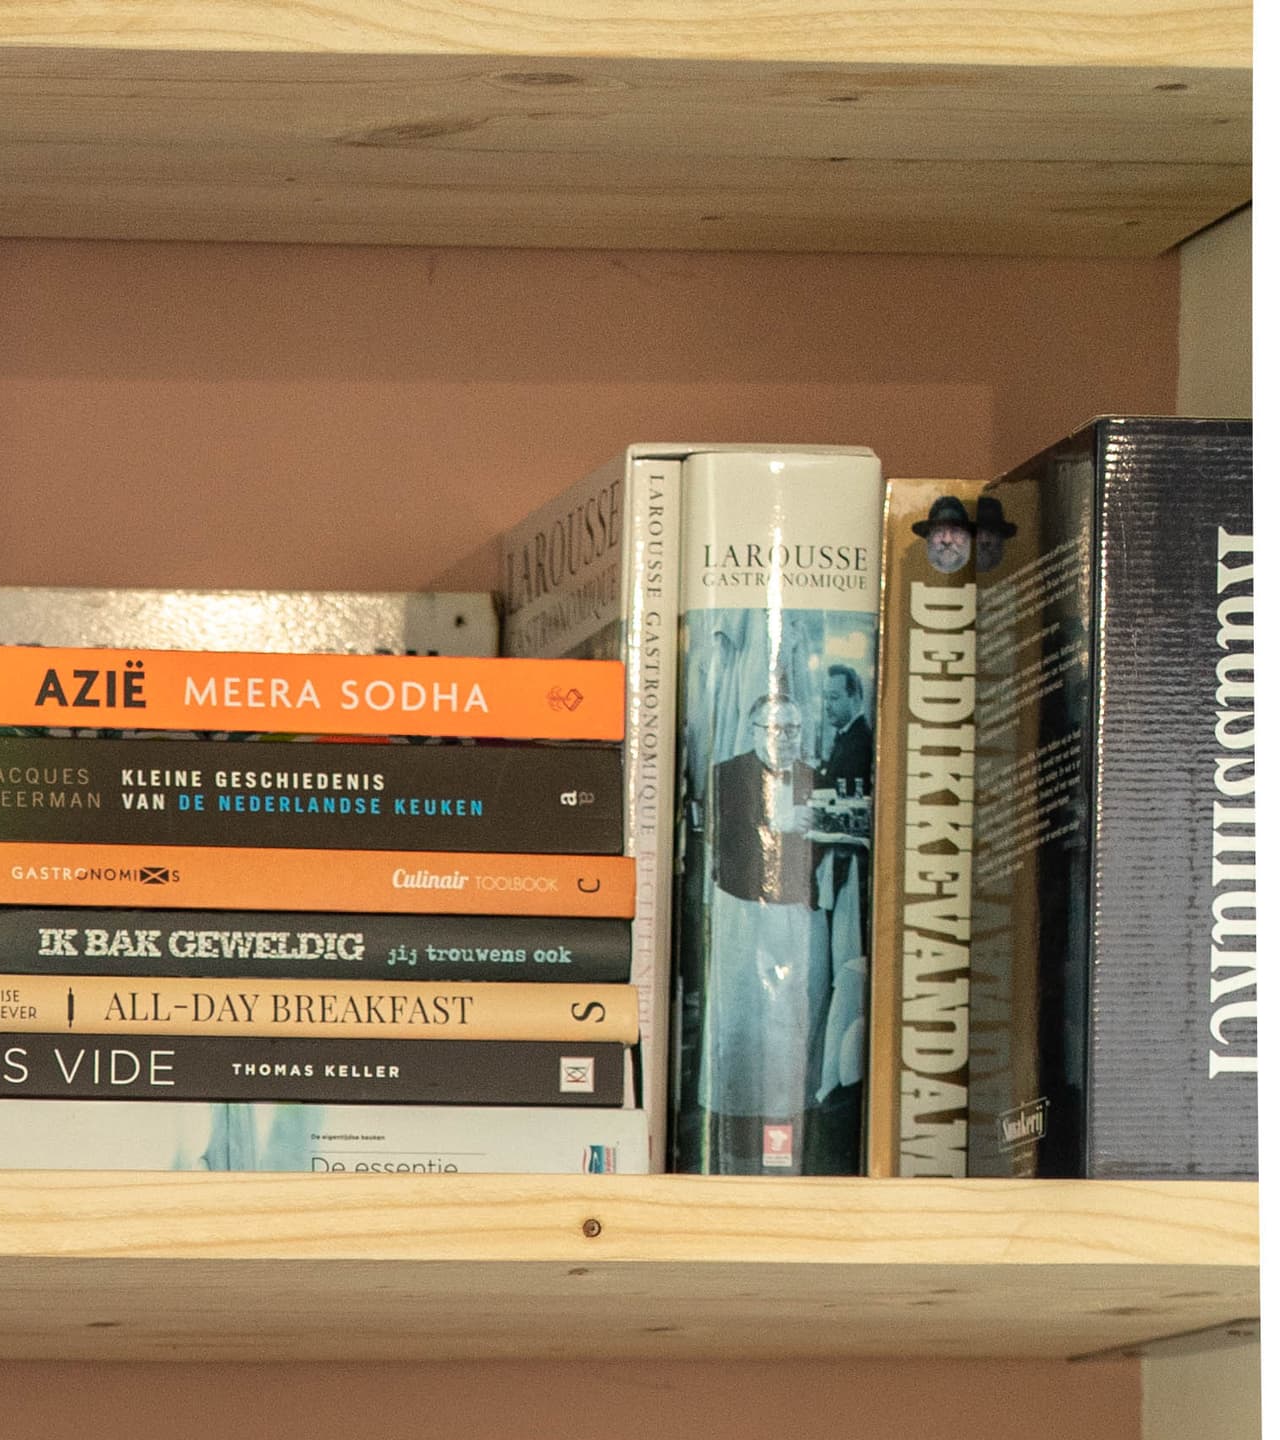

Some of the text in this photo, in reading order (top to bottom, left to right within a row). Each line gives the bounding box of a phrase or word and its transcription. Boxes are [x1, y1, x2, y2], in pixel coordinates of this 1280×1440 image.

[647, 474, 665, 599] LAROUSSE
[704, 543, 869, 572] LAROUSSE
[702, 571, 869, 593] GASTRNOMIQUE
[34, 660, 489, 713] AZIË MEERA SODHA
[640, 611, 662, 836] GASTRONOMIQUE
[121, 769, 385, 791] KLEINE GESCHIEDENIS
[121, 793, 483, 817] VAN DE NEDERLANDSE KEUKEN
[392, 868, 559, 892] Culinair TOOLBOOK
[38, 928, 79, 956] IK
[84, 929, 163, 958] BAK
[387, 946, 418, 966] jij
[425, 944, 526, 963] trouwens
[533, 946, 572, 964] ook
[104, 991, 474, 1025] ALL-DAY BREAKFAST
[53, 1048, 176, 1086] VIDE
[231, 1063, 401, 1079] THOMAS KELLER
[311, 1157, 458, 1174] De essentie
